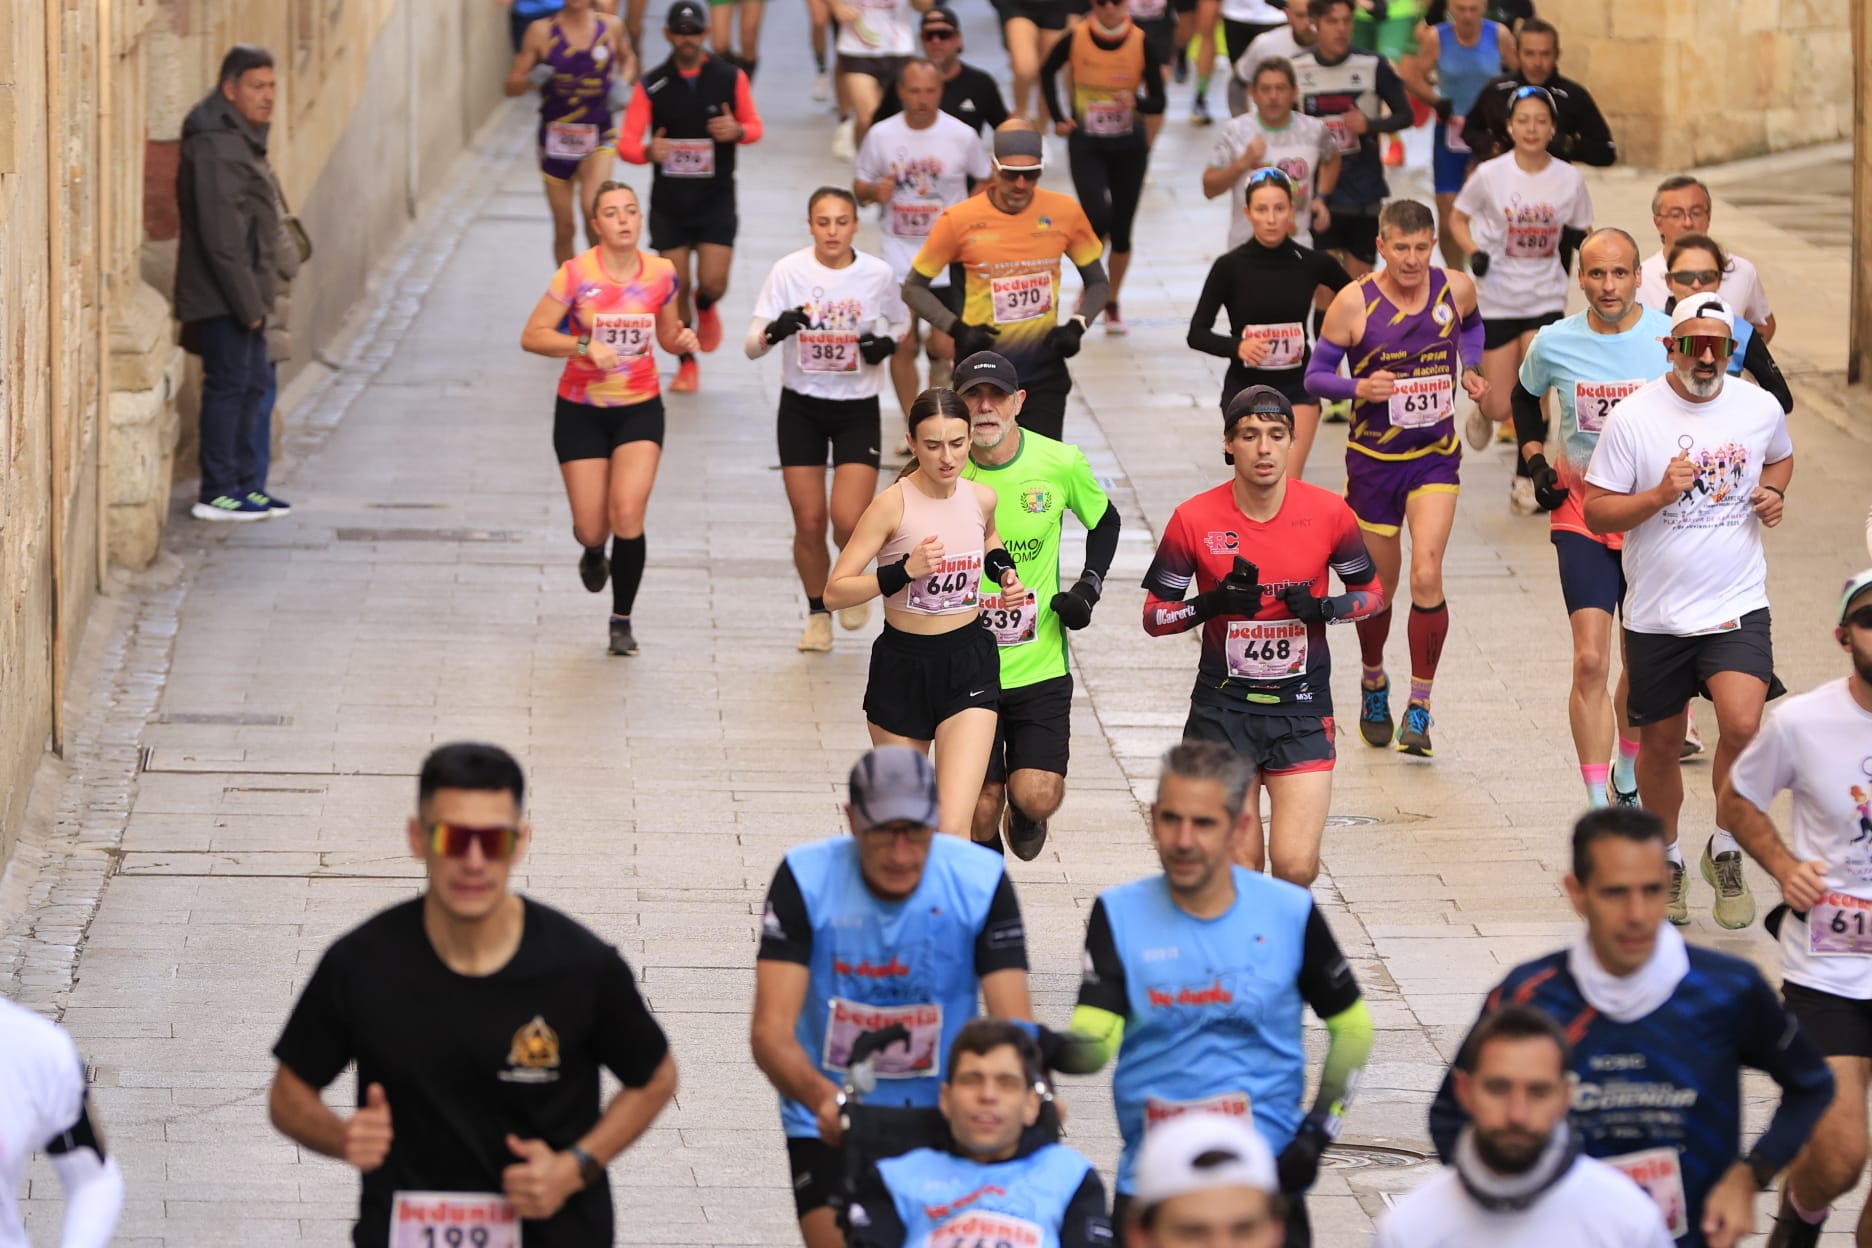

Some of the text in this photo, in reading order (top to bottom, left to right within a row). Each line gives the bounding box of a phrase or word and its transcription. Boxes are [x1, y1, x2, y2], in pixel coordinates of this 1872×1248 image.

[993, 276, 1050, 293] bedunia
[1008, 288, 1040, 308] 370
[596, 317, 652, 328] bedunia
[606, 329, 641, 344] 313
[799, 332, 859, 345] bedunia
[811, 344, 846, 360] 382
[1270, 339, 1290, 355] 71
[1420, 350, 1448, 363] PRIM
[1577, 384, 1640, 398] beduni
[1404, 393, 1438, 412] 631
[936, 555, 982, 574] dunia
[927, 572, 968, 596] 640
[981, 609, 1022, 630] 639
[1229, 624, 1305, 640] bedunia
[1244, 639, 1290, 661] 468
[1831, 909, 1872, 935] 61
[422, 1226, 489, 1248] 199
